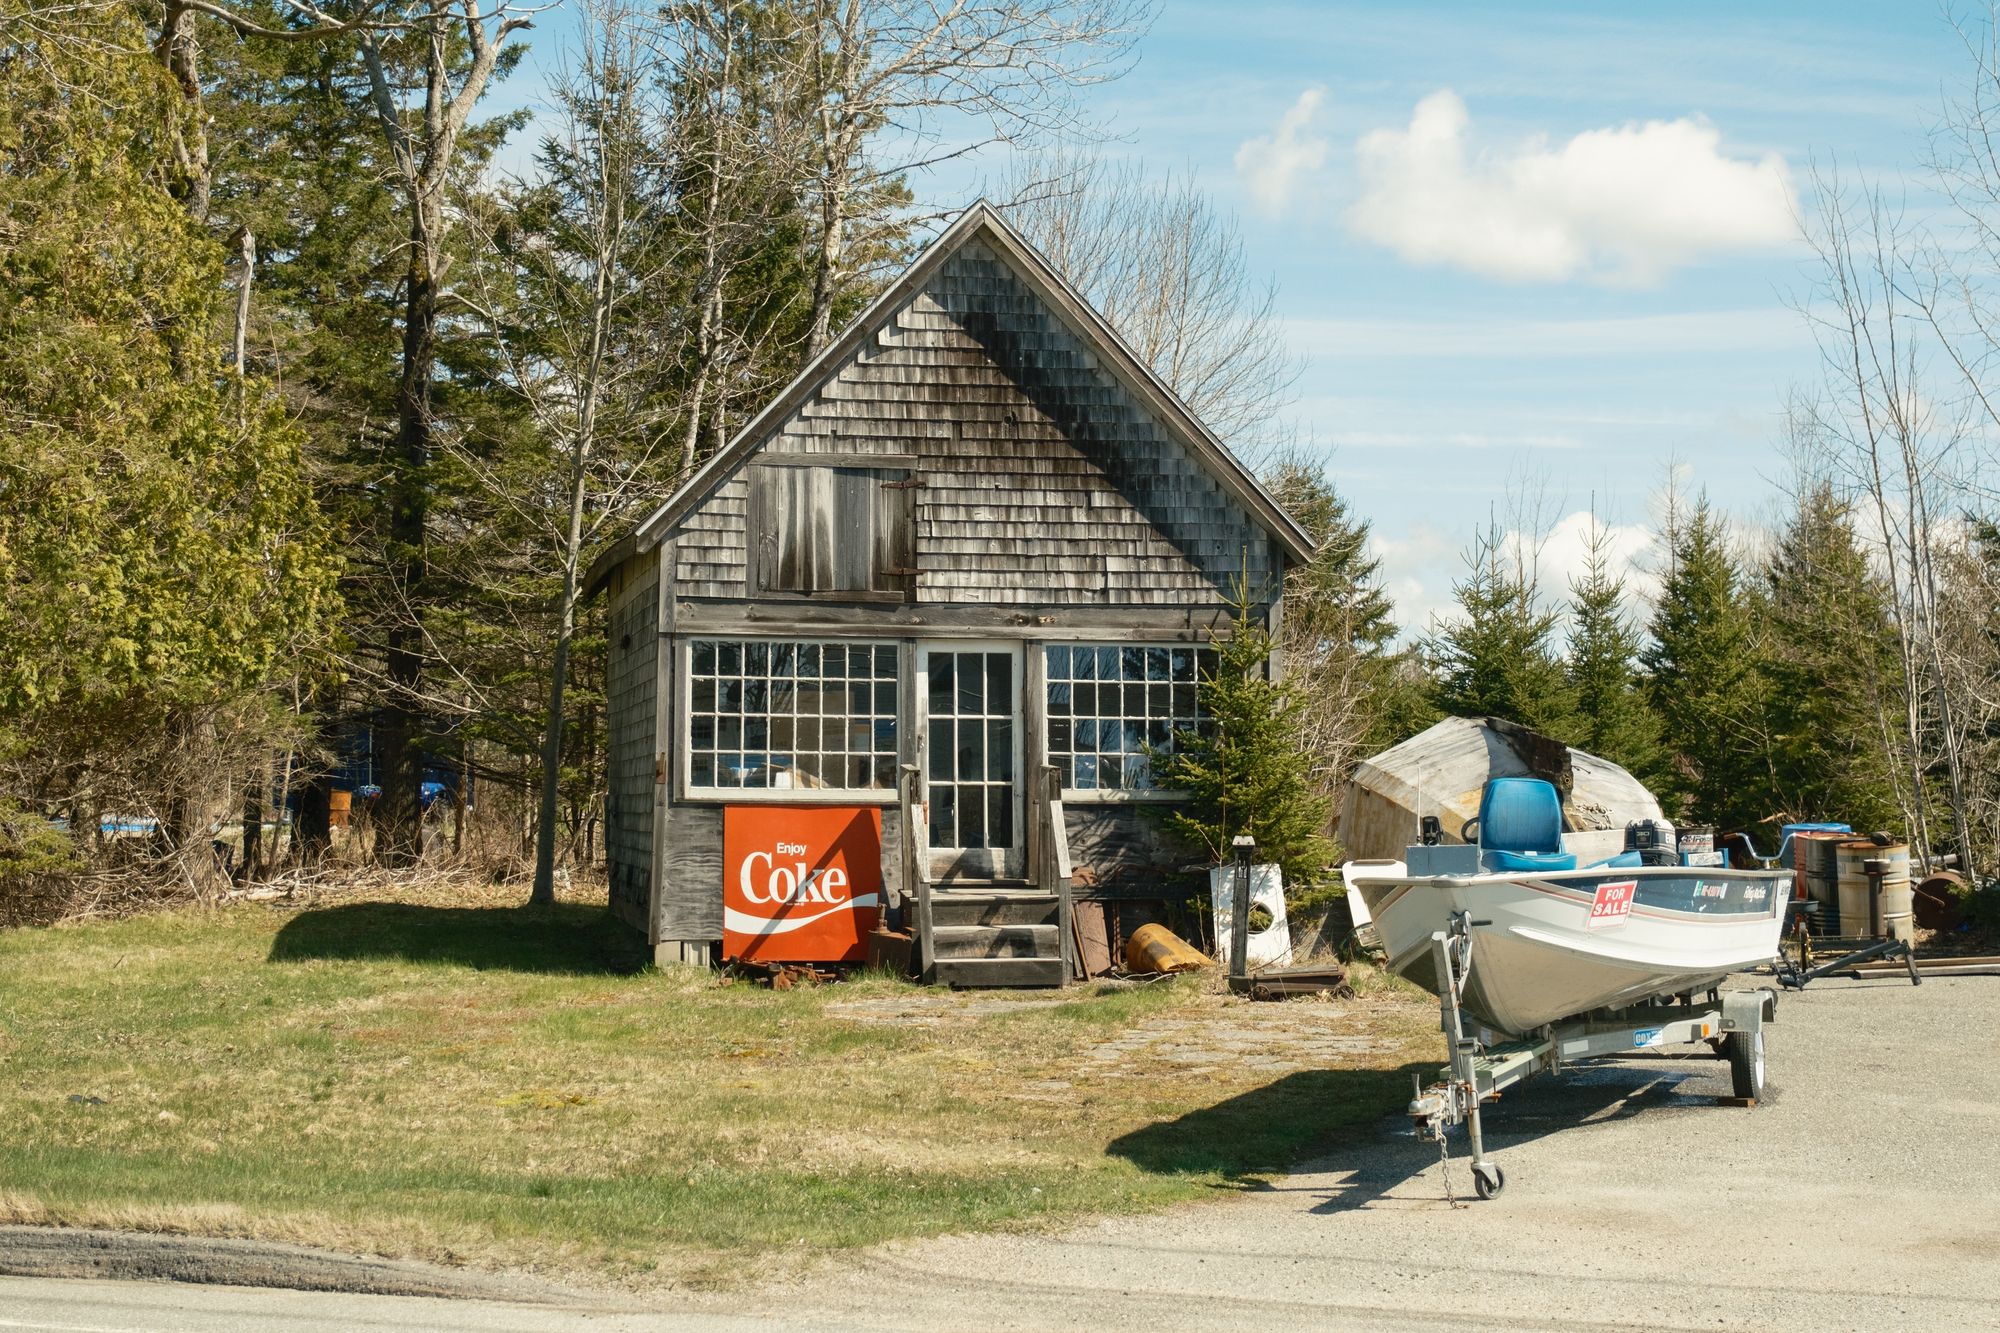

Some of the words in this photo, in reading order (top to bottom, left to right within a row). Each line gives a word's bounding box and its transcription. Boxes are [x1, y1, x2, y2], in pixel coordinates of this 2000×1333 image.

[776, 842, 807, 856] Enjoy
[740, 851, 847, 904] Coke
[1605, 888, 1625, 901] FOR
[1593, 900, 1629, 915] SALE
